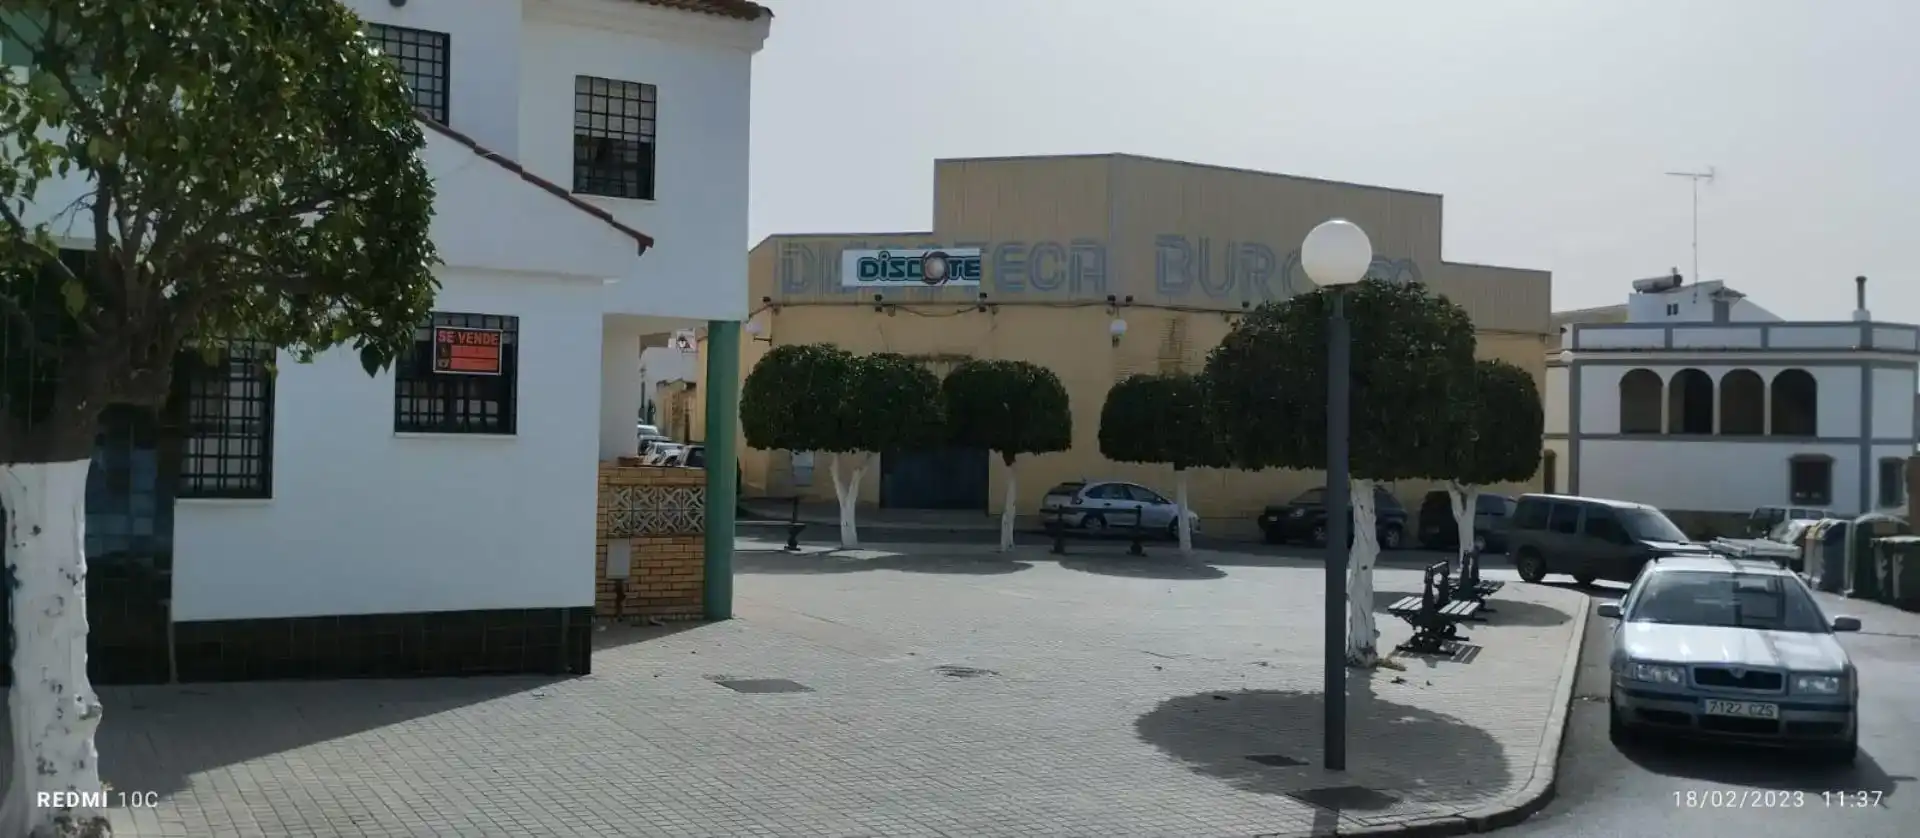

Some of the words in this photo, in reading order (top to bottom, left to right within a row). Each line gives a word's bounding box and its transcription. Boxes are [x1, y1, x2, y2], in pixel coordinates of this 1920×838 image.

[437, 329, 455, 343] SE
[457, 331, 499, 346] VENDE
[1709, 700, 1742, 714] 7122
